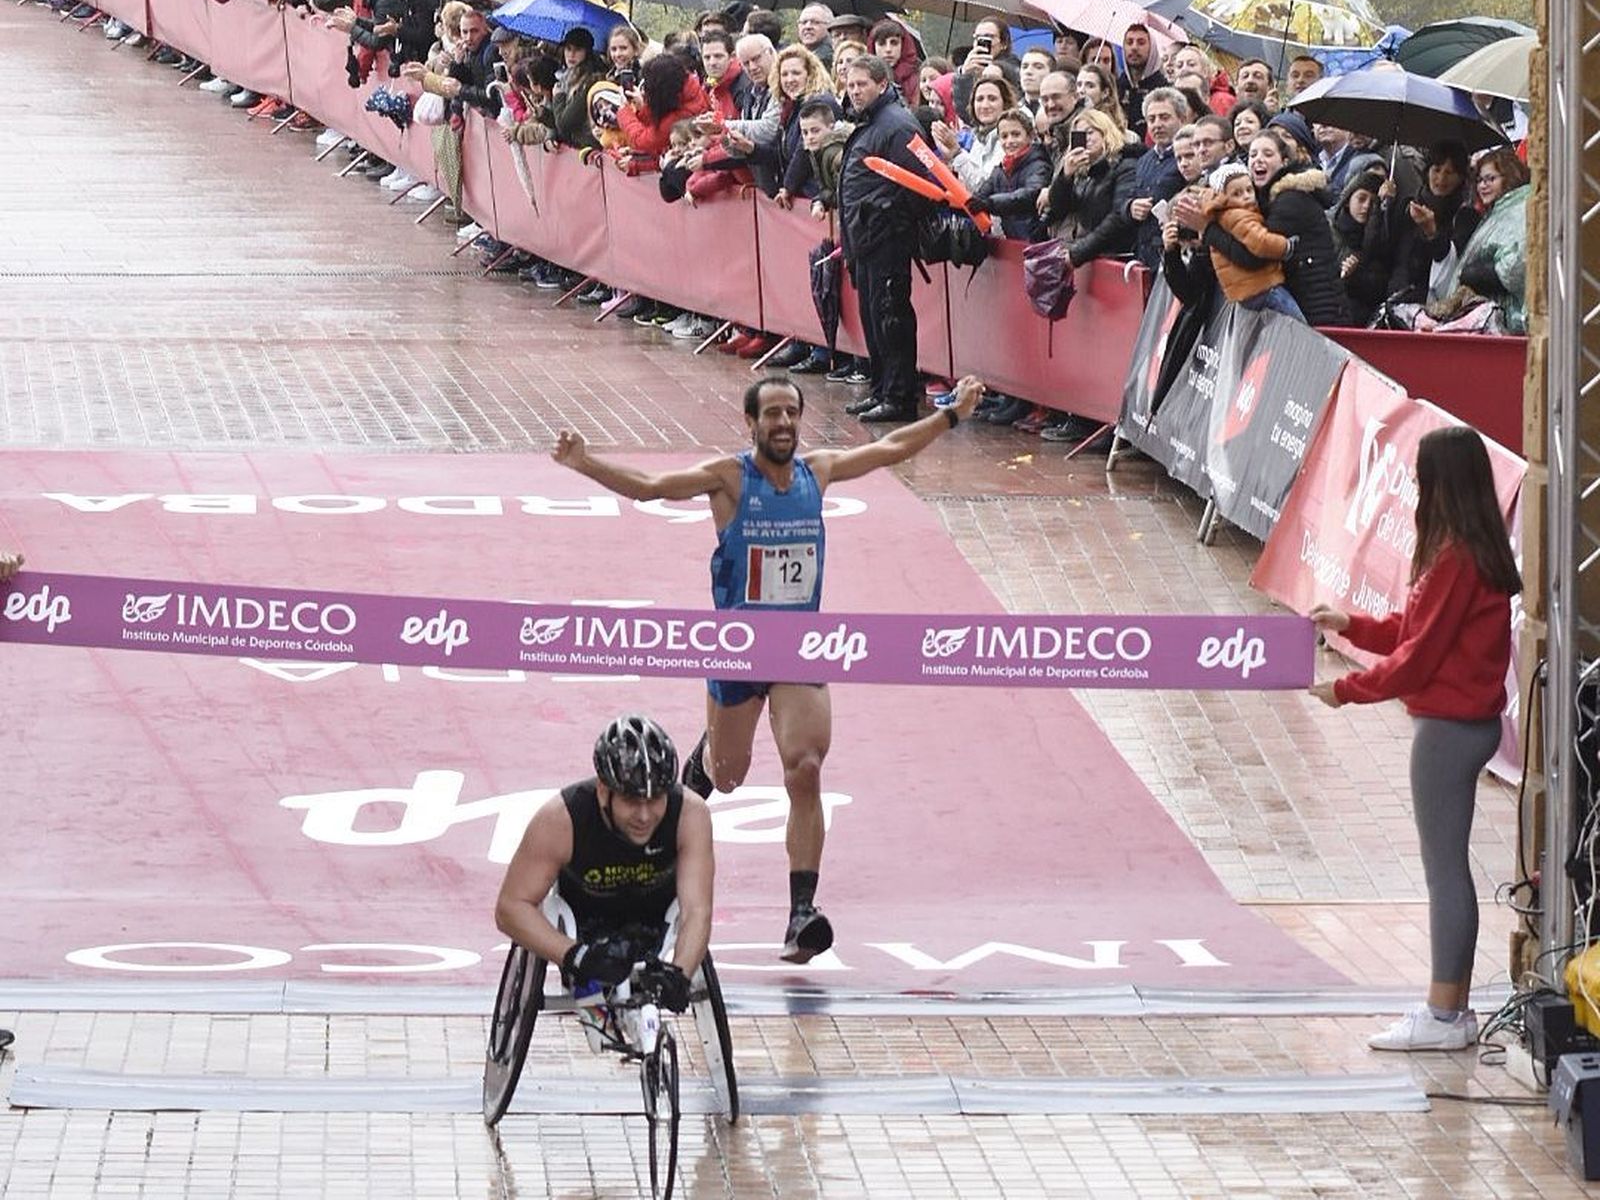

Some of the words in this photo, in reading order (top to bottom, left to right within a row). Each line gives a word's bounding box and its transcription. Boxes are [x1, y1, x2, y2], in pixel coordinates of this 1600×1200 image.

[779, 561, 802, 584] 12
[3, 584, 72, 634] edp
[178, 593, 357, 636] IMDECO
[122, 628, 170, 642] Instituto
[171, 631, 229, 648] Municipal
[231, 635, 247, 647] de
[249, 638, 302, 651] Deportes
[303, 640, 354, 653] Córdoba
[399, 609, 471, 657] edp
[574, 616, 756, 653] IMDECO
[797, 623, 869, 672] edp
[975, 625, 1152, 662] IMDECO
[519, 650, 567, 664] Instituto
[569, 652, 627, 667] Municipal
[628, 654, 645, 667] de
[646, 655, 700, 670] Deportes
[701, 658, 752, 671] Córdoba
[921, 663, 969, 676] Instituto
[970, 664, 1027, 679] Municipal
[1028, 664, 1044, 677] de
[1045, 665, 1099, 680] Deportes
[1100, 666, 1149, 679] Córdoba
[1196, 627, 1267, 679] edp
